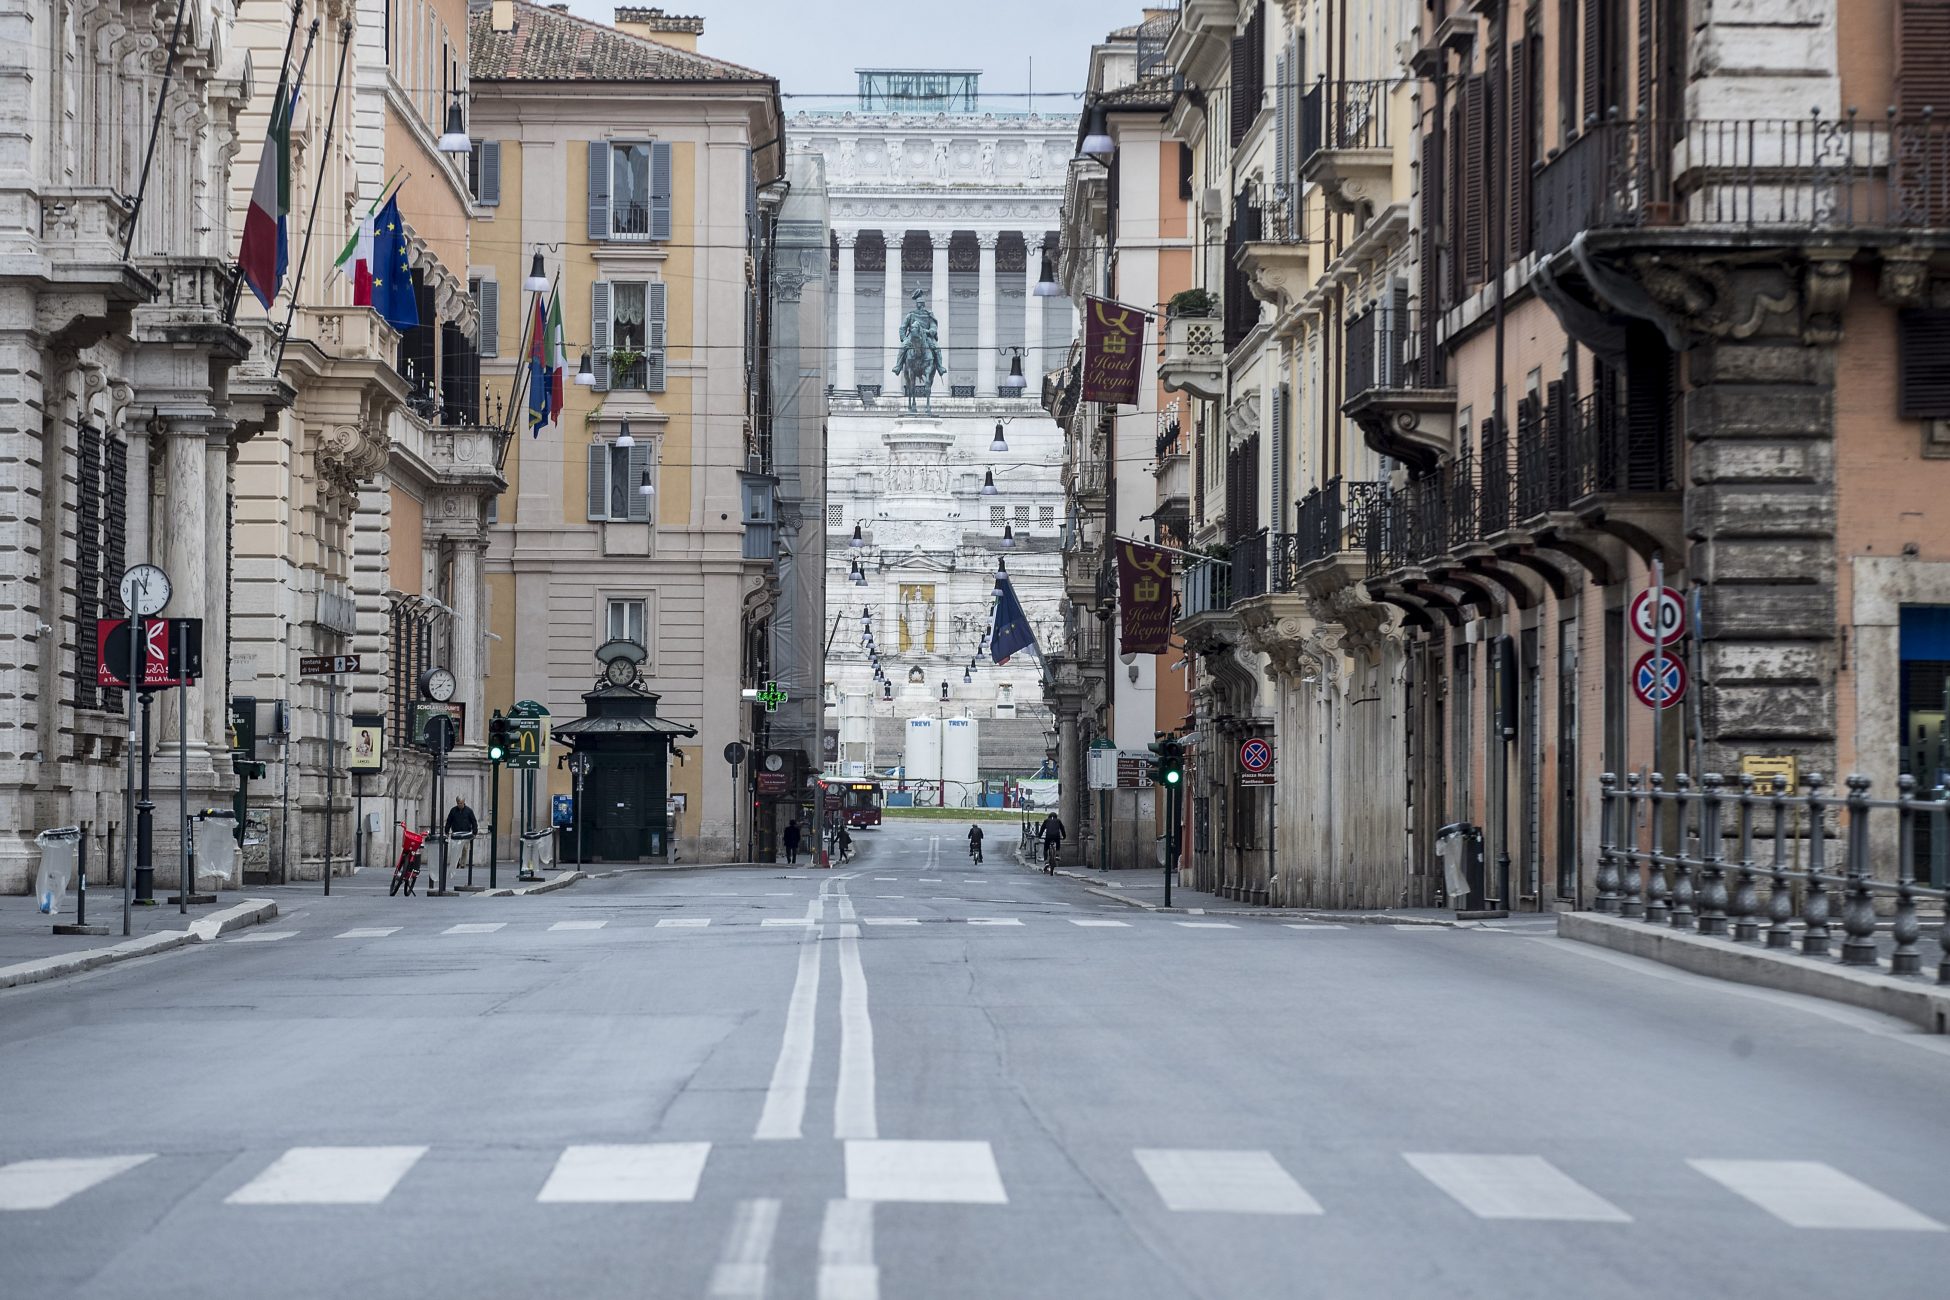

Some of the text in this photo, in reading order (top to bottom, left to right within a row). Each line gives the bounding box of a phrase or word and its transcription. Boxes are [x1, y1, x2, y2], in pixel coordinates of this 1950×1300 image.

[1091, 355, 1136, 370] Hotel
[1087, 370, 1134, 390] Regno
[140, 567, 150, 577] 12
[122, 587, 129, 596] 9
[143, 604, 149, 613] 6
[1126, 606, 1168, 620] Hotel
[1124, 621, 1169, 640] Regno
